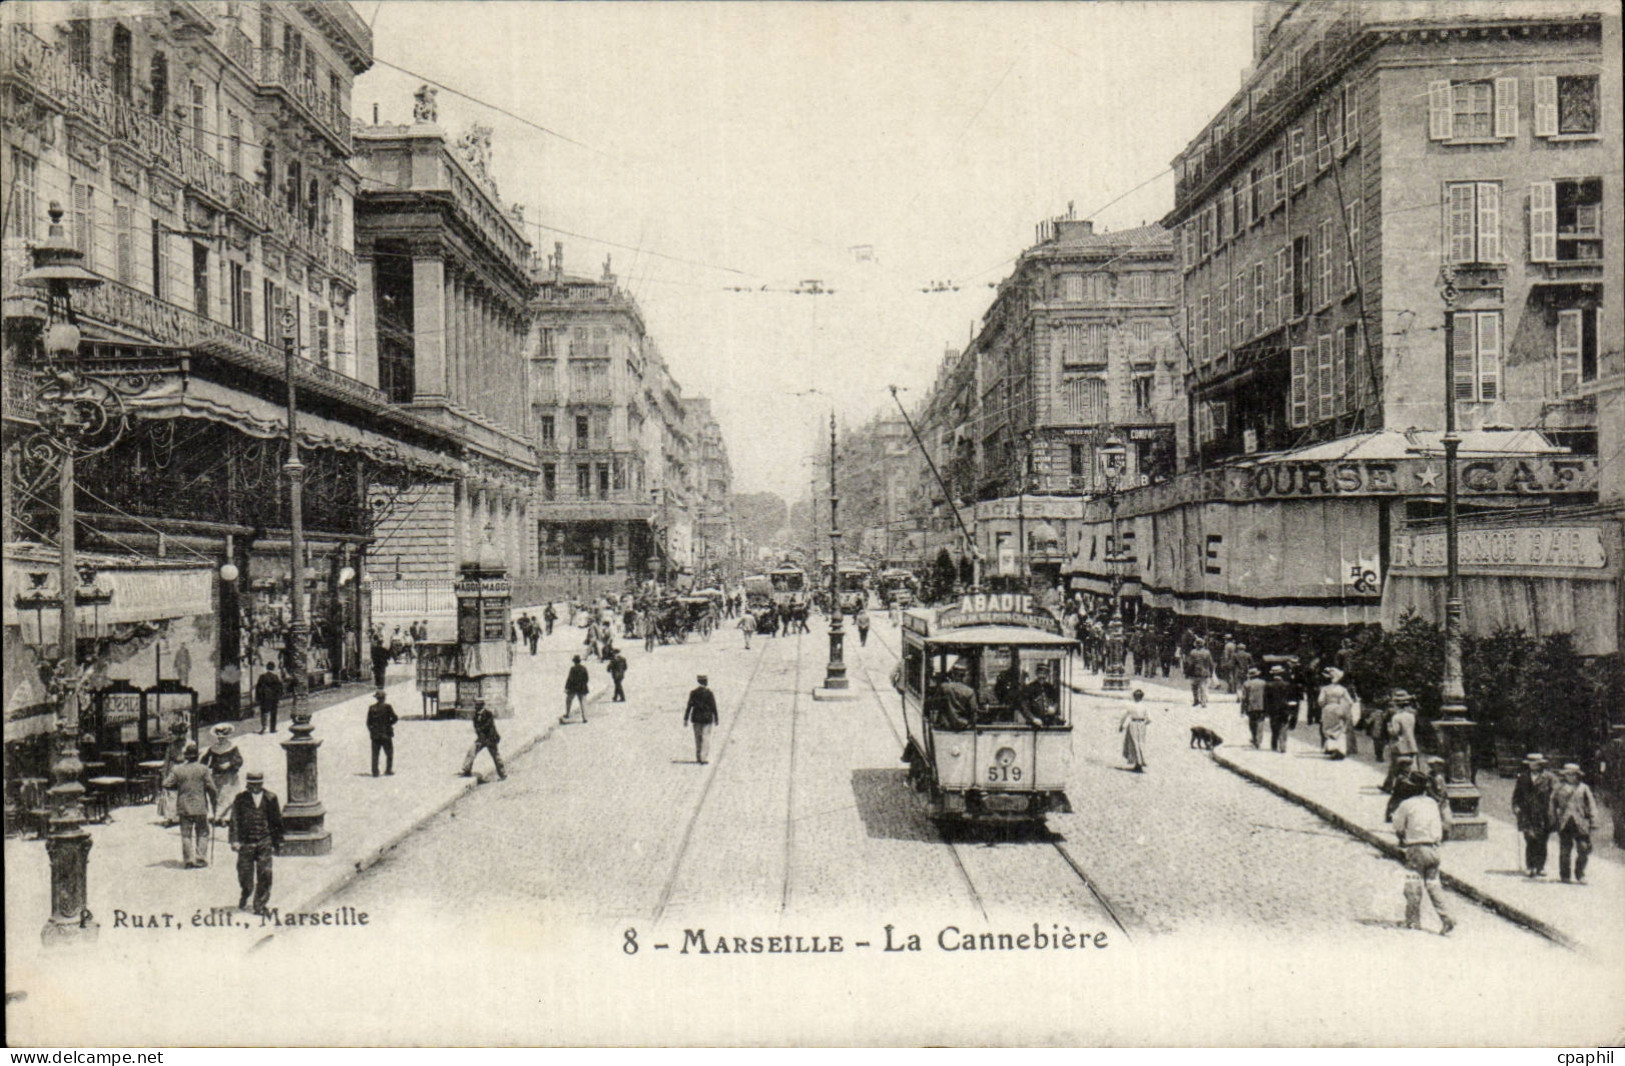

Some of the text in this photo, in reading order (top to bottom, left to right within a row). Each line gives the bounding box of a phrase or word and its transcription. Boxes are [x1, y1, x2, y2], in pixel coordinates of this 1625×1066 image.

[960, 593, 1034, 614] ABADIE
[988, 766, 1022, 782] 519
[260, 906, 371, 928] Marseille
[622, 927, 640, 955] 8
[680, 928, 845, 955] MARSEILLE
[883, 924, 923, 953] La
[937, 923, 1109, 952] Cannebière
